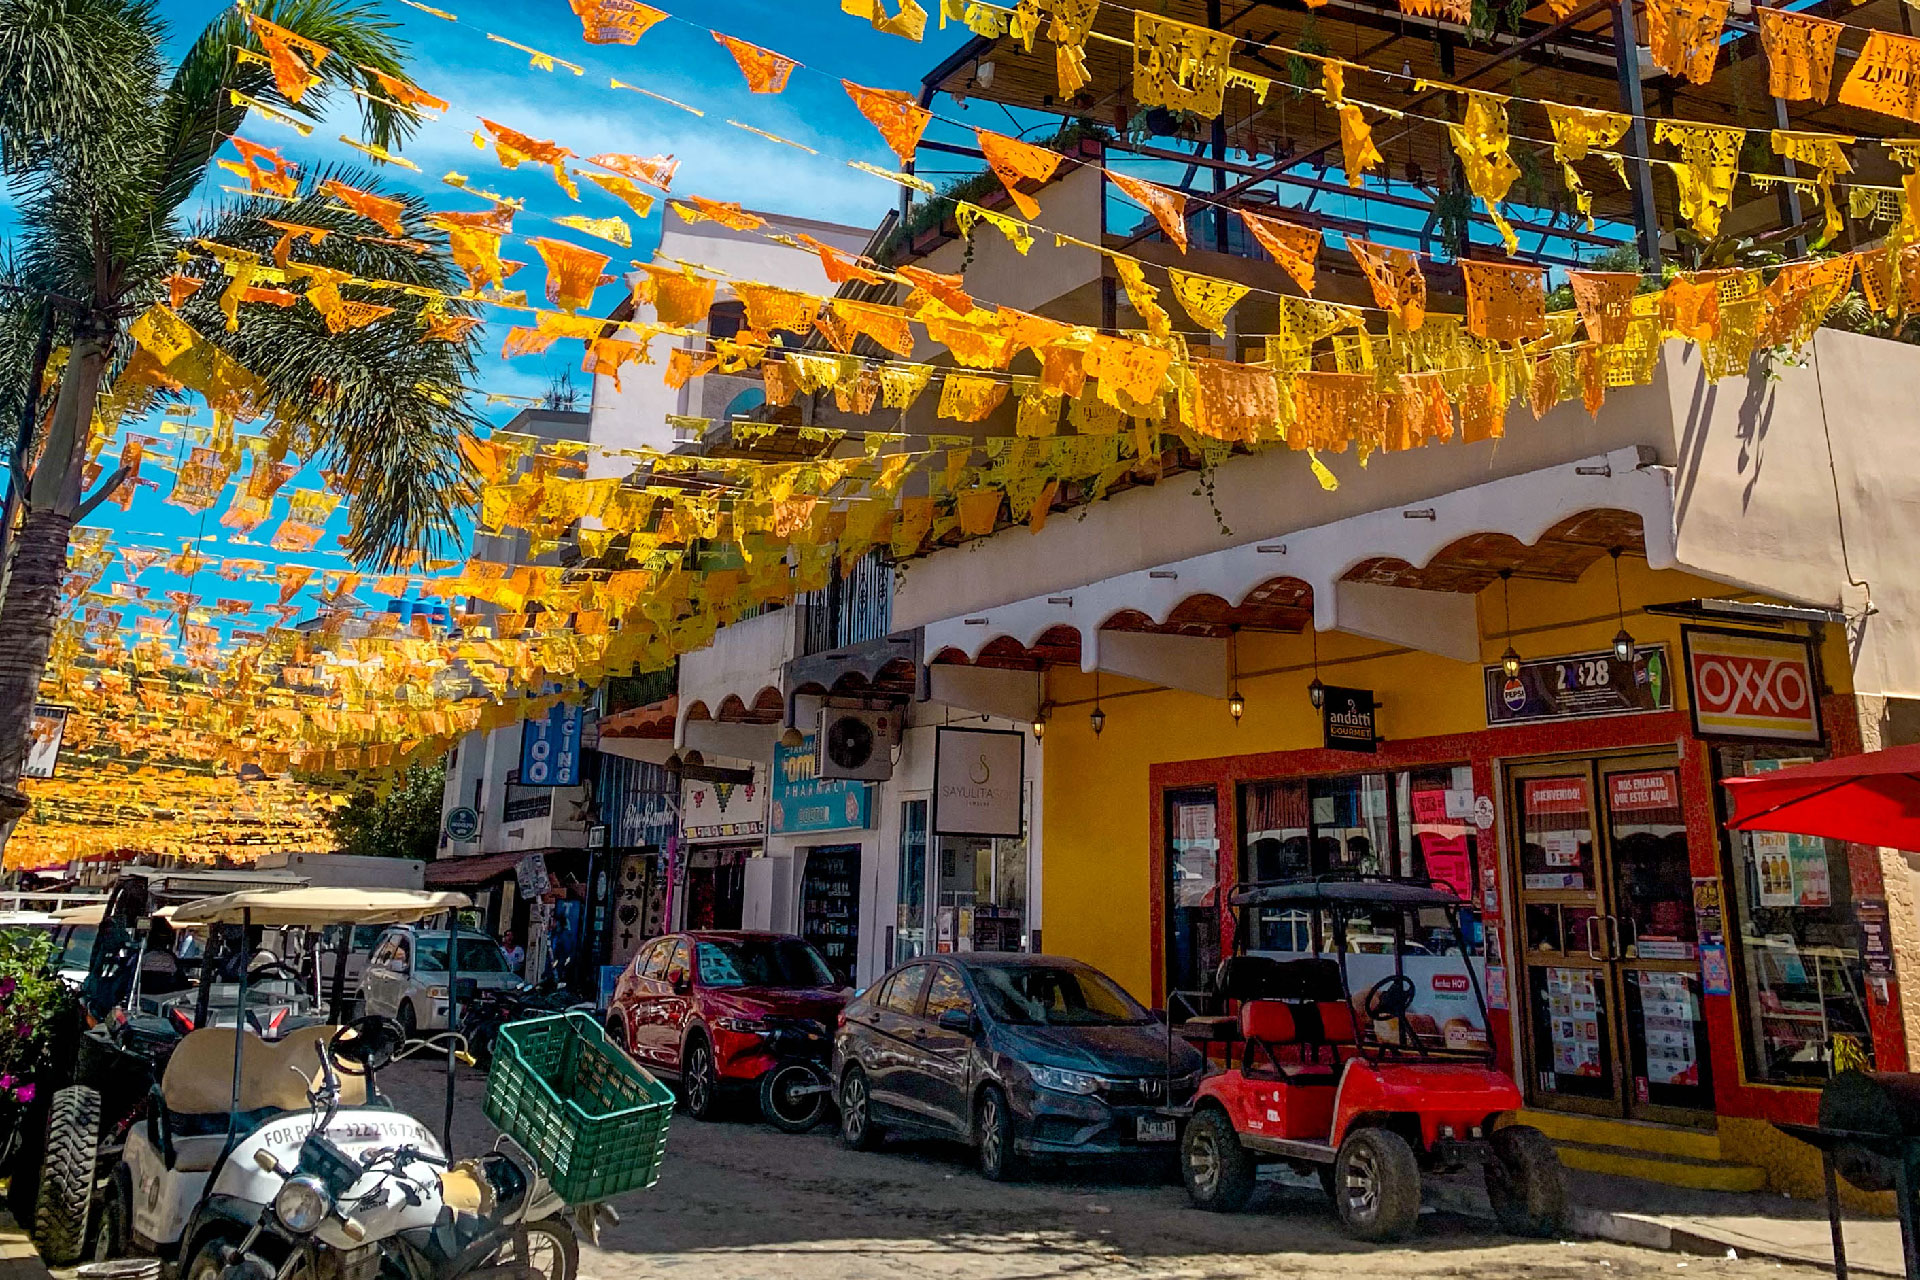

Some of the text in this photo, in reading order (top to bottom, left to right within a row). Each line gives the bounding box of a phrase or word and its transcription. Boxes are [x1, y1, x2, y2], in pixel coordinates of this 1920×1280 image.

[1700, 660, 1806, 714] OXXO
[1505, 690, 1525, 699] PEPSI
[1330, 710, 1371, 727] andatti
[1331, 727, 1371, 738] GOURMET
[1618, 777, 1665, 791] NOS ENCANTA
[1614, 793, 1628, 806] QUE
[264, 1127, 293, 1147] FOR
